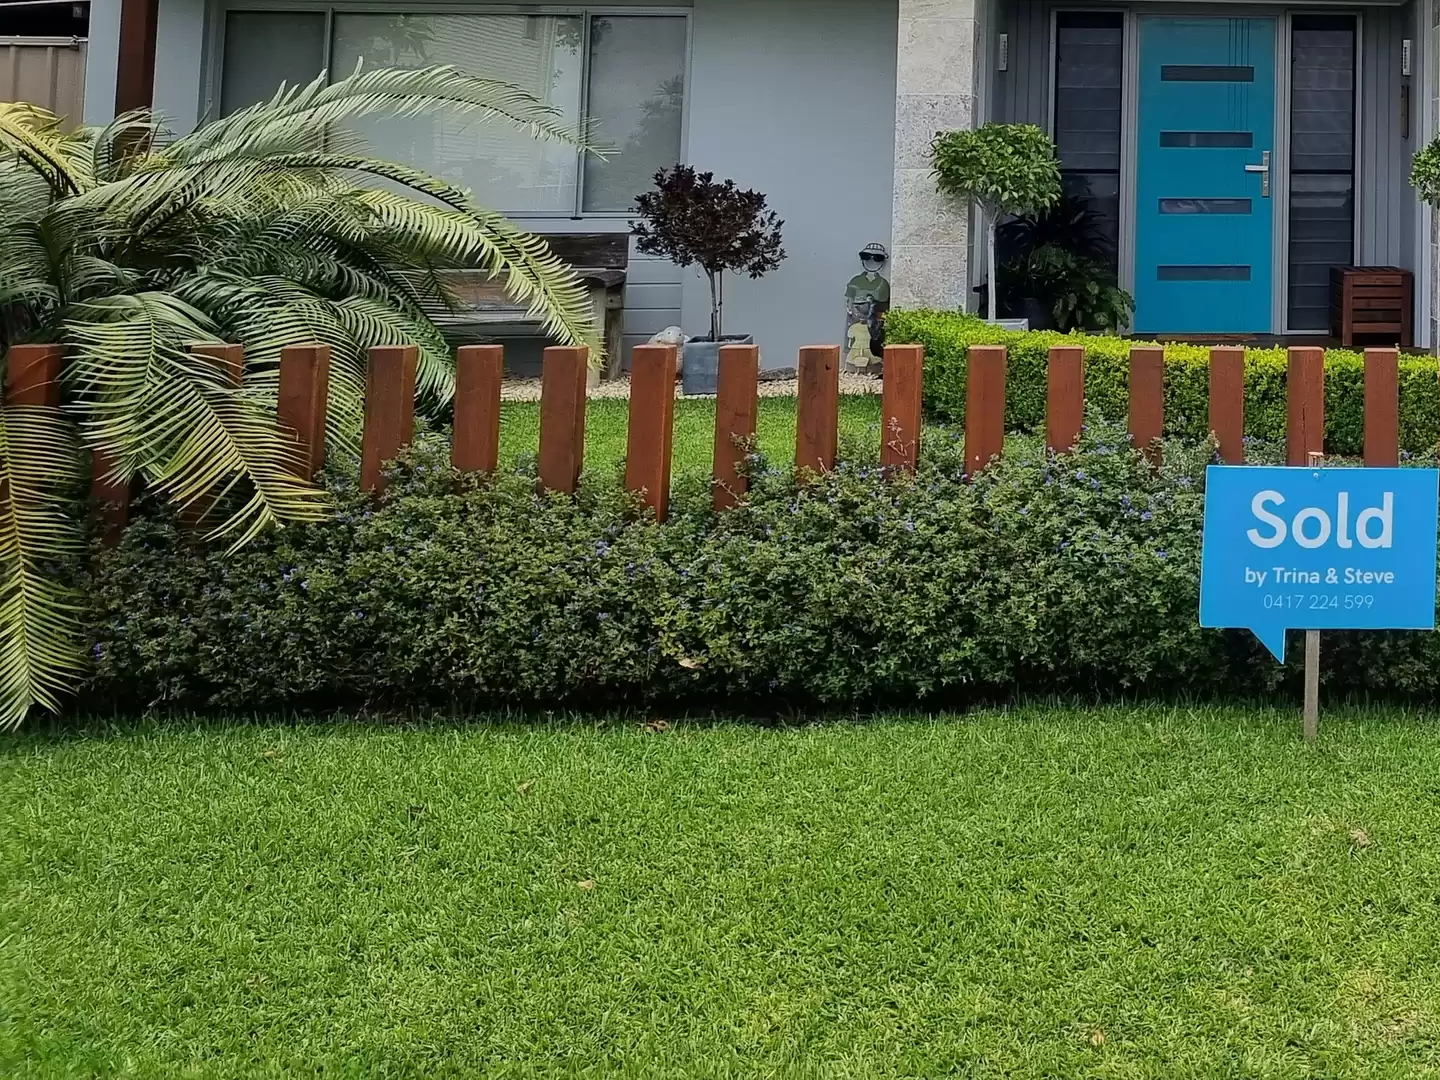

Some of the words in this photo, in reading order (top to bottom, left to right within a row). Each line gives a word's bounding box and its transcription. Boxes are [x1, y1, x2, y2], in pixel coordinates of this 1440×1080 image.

[1246, 489, 1394, 549] Sold
[1245, 567, 1267, 587] by
[1272, 567, 1320, 584] Trina
[1325, 568, 1339, 585] &
[1344, 567, 1395, 585] Steve
[1263, 594, 1304, 609] 0417
[1309, 594, 1338, 610] 224
[1344, 594, 1375, 610] 599
